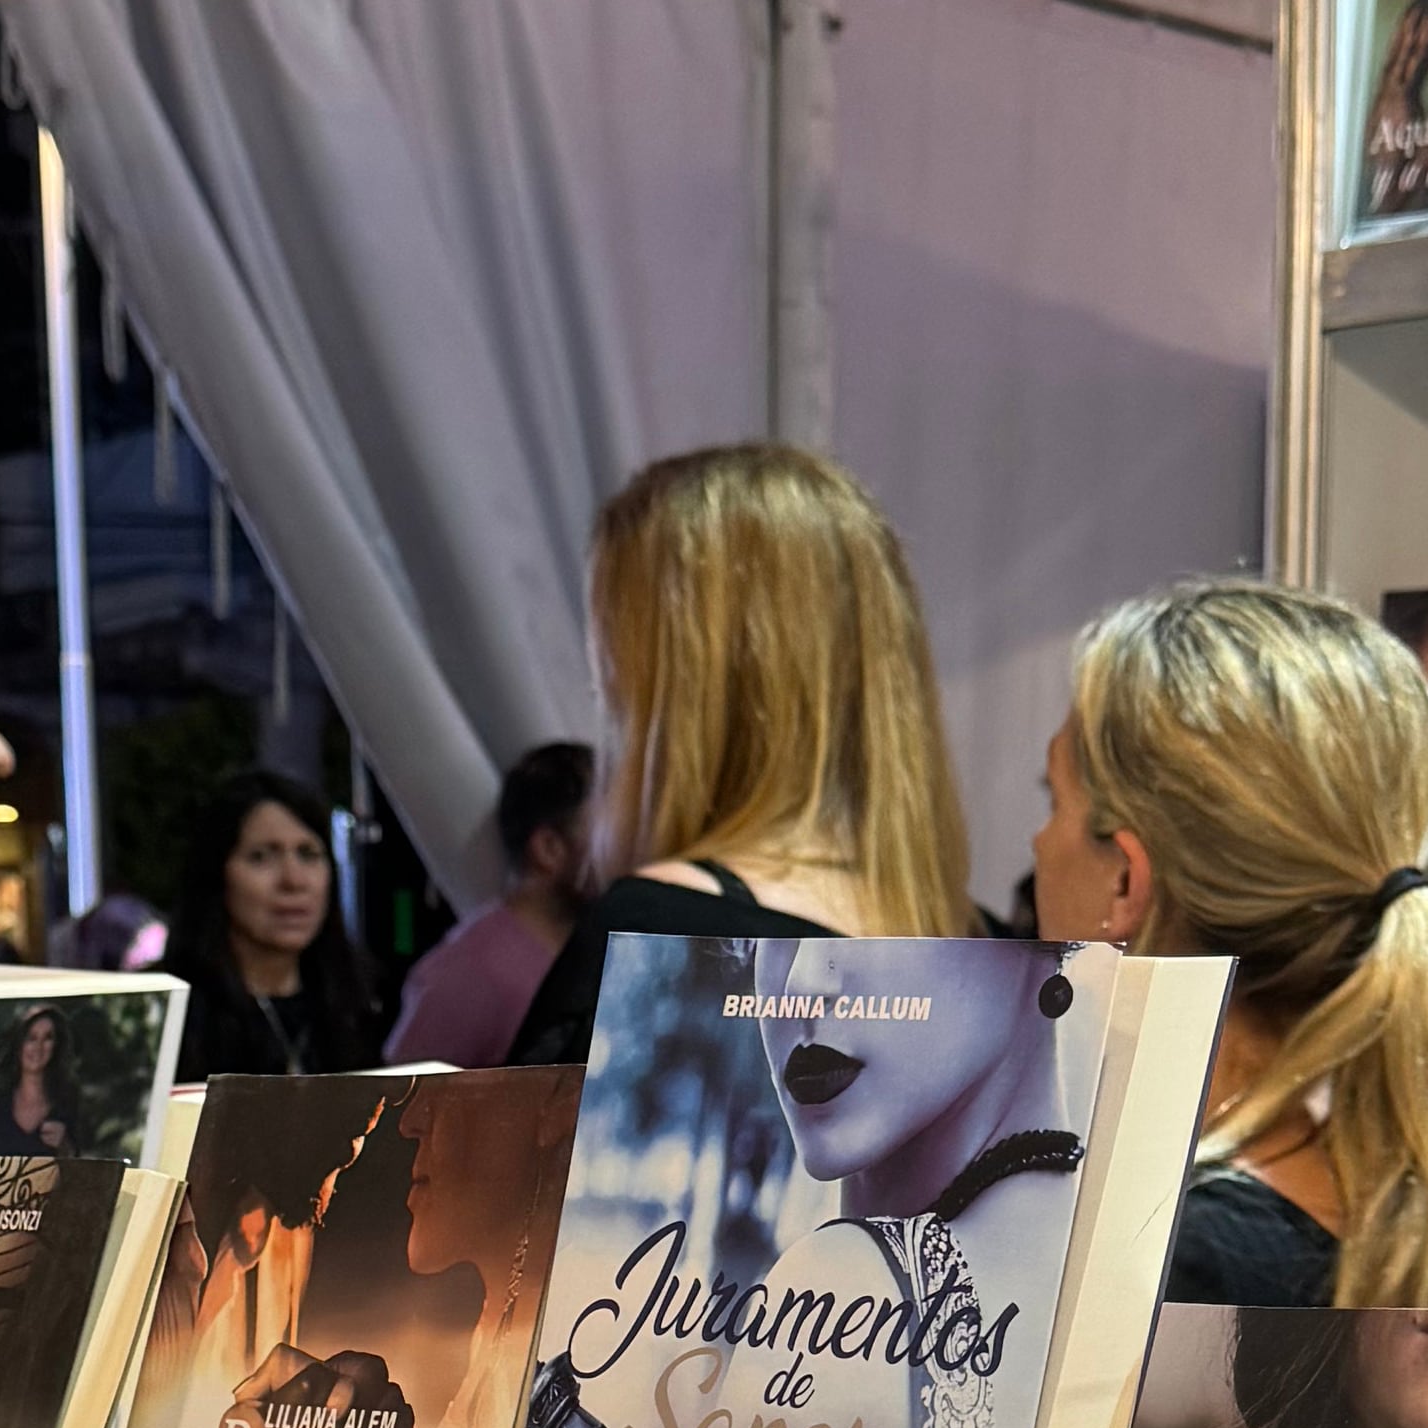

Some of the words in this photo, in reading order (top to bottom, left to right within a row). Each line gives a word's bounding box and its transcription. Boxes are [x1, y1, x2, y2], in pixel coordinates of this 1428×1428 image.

[723, 994, 826, 1019] BRIANNA
[833, 995, 932, 1021] CALLUM
[567, 1220, 1020, 1379] Juramentos
[763, 1351, 815, 1409] de
